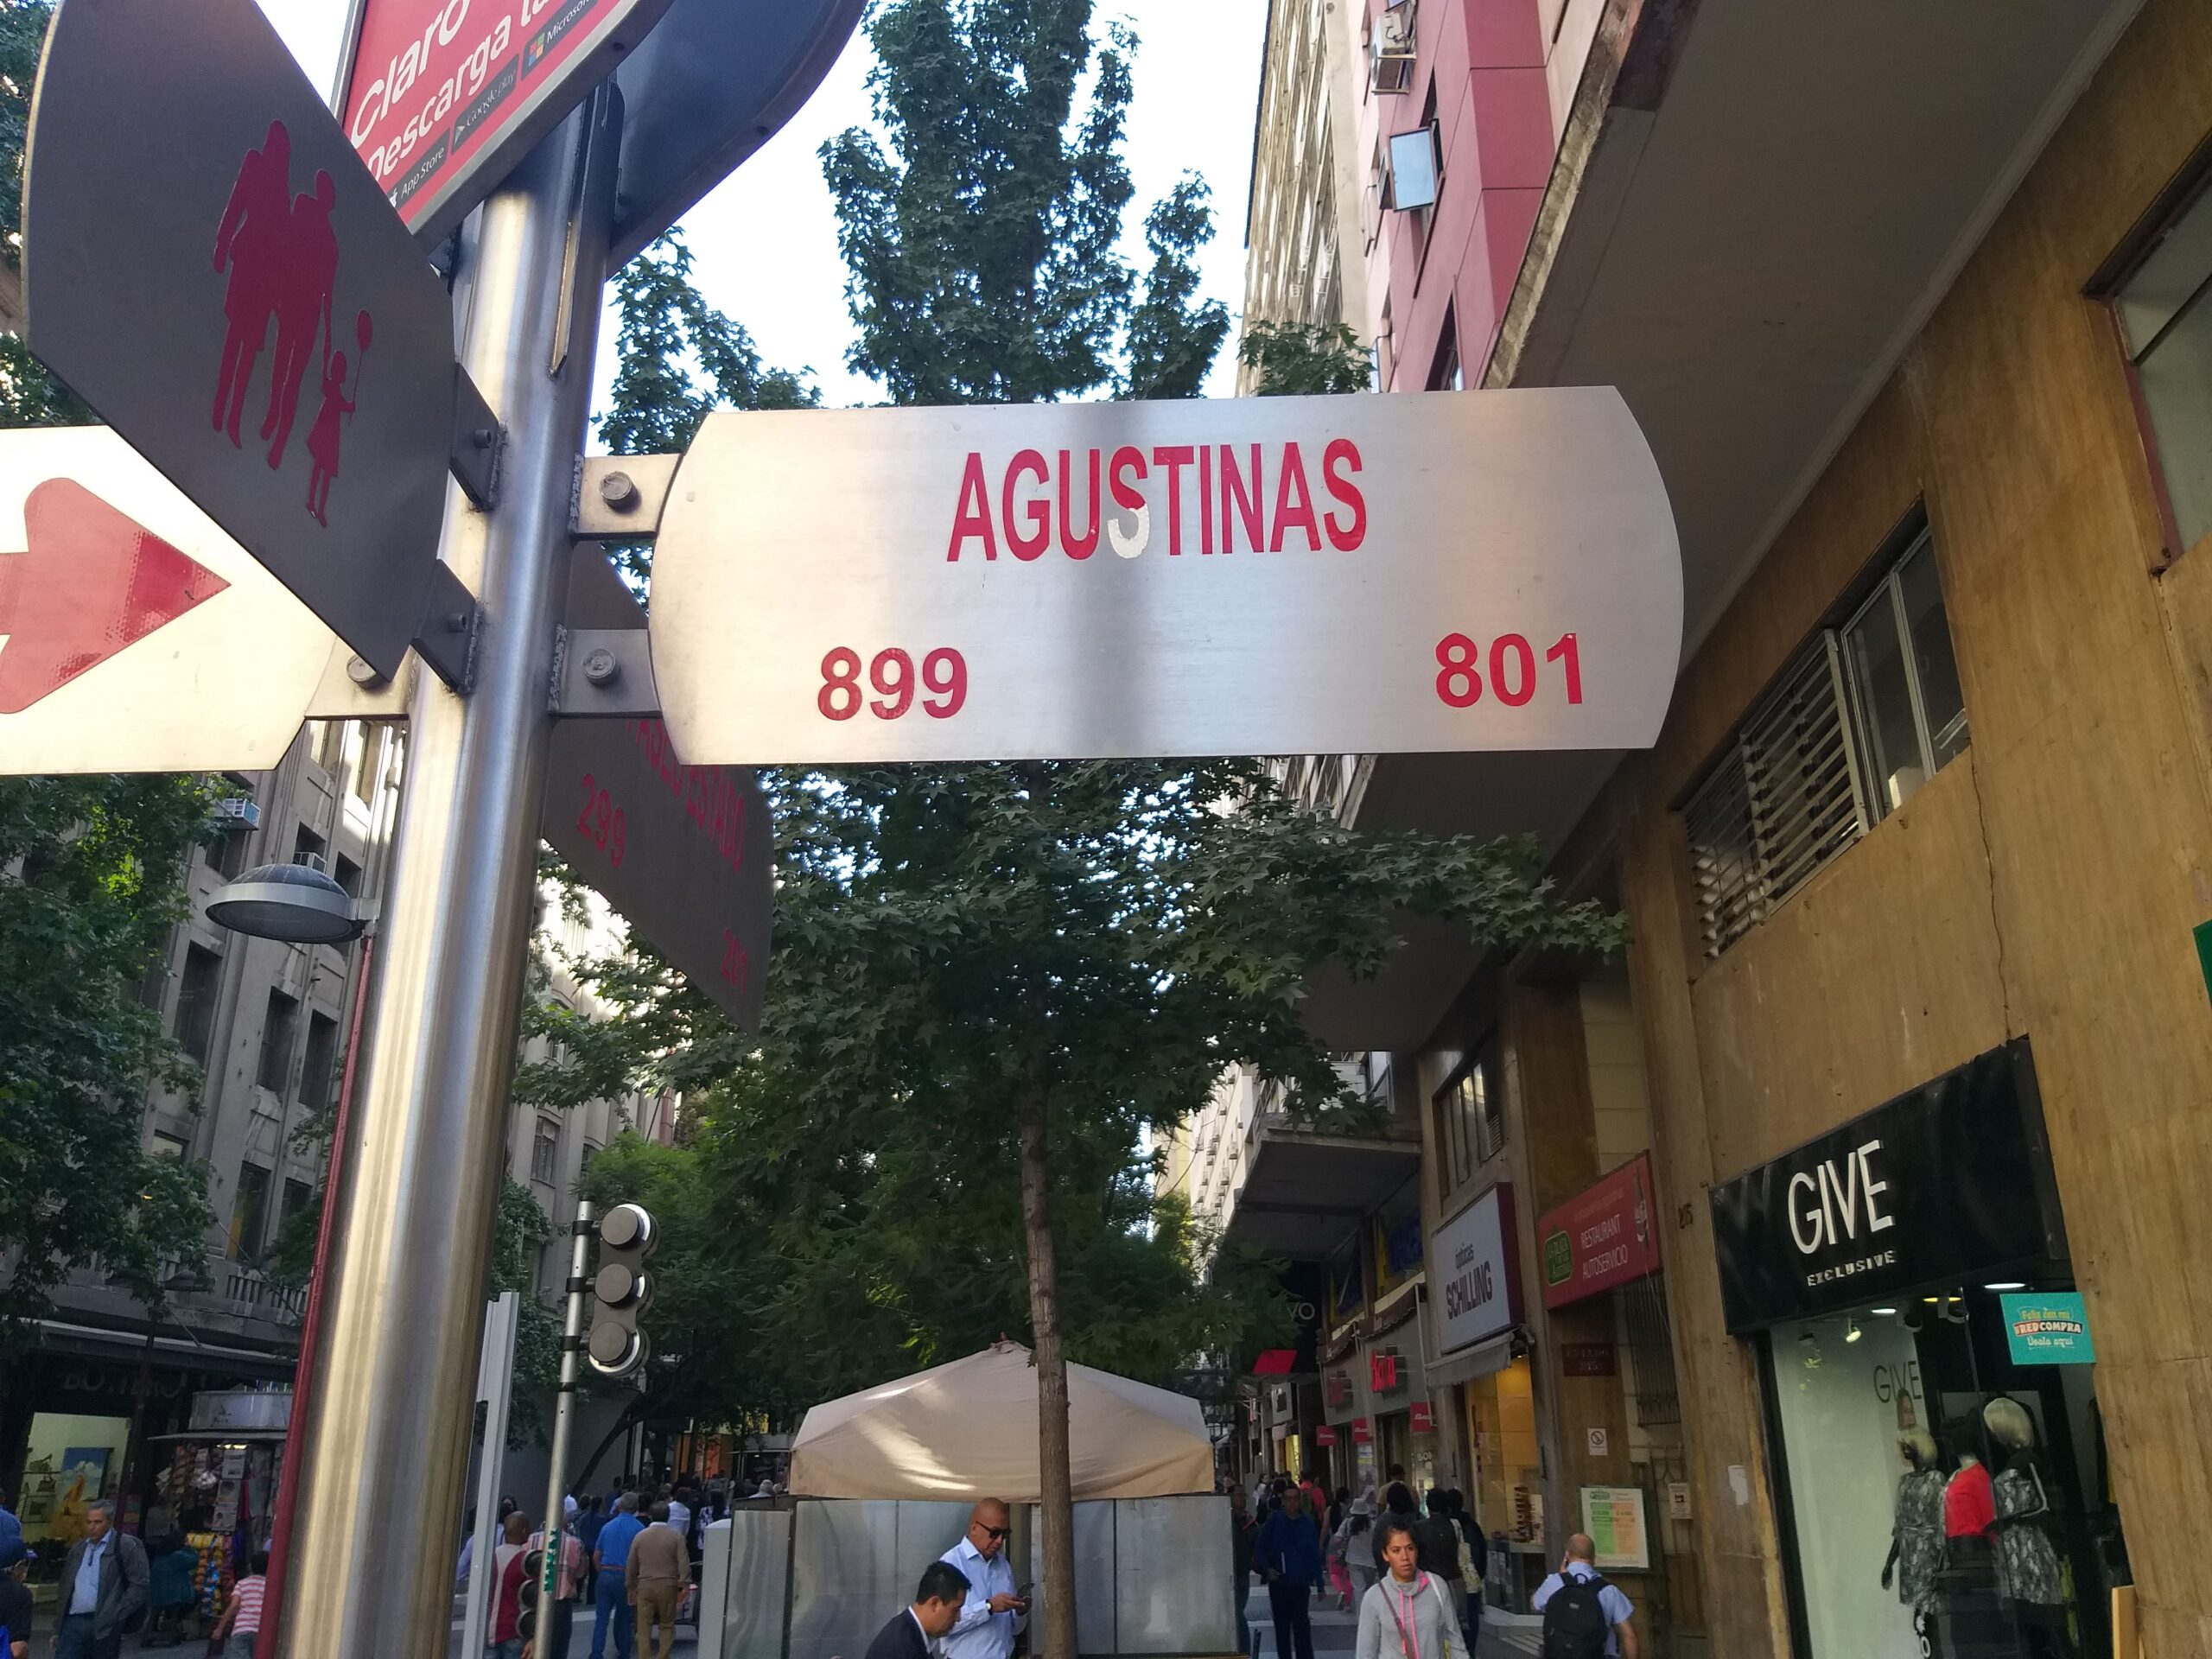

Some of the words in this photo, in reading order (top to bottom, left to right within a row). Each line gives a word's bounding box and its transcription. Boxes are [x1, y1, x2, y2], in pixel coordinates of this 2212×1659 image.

[351, 0, 470, 149] Claro
[401, 173, 420, 199] App
[420, 147, 445, 179] Store
[947, 438, 1369, 563] AGUSTINAS
[817, 645, 968, 721] 899
[1434, 632, 1583, 709] 801
[577, 772, 626, 868] 299
[1788, 1139, 1895, 1255] GIVE
[1580, 1213, 1621, 1251] RESTAURANT
[1582, 1243, 1629, 1281] AUTOSERVICIO
[1807, 1249, 1897, 1287] EXCLUSIVE
[1446, 1261, 1493, 1320] SCHILLING
[2017, 1321, 2082, 1335] REDCOMPRA
[1873, 1361, 1923, 1403] GIVE
